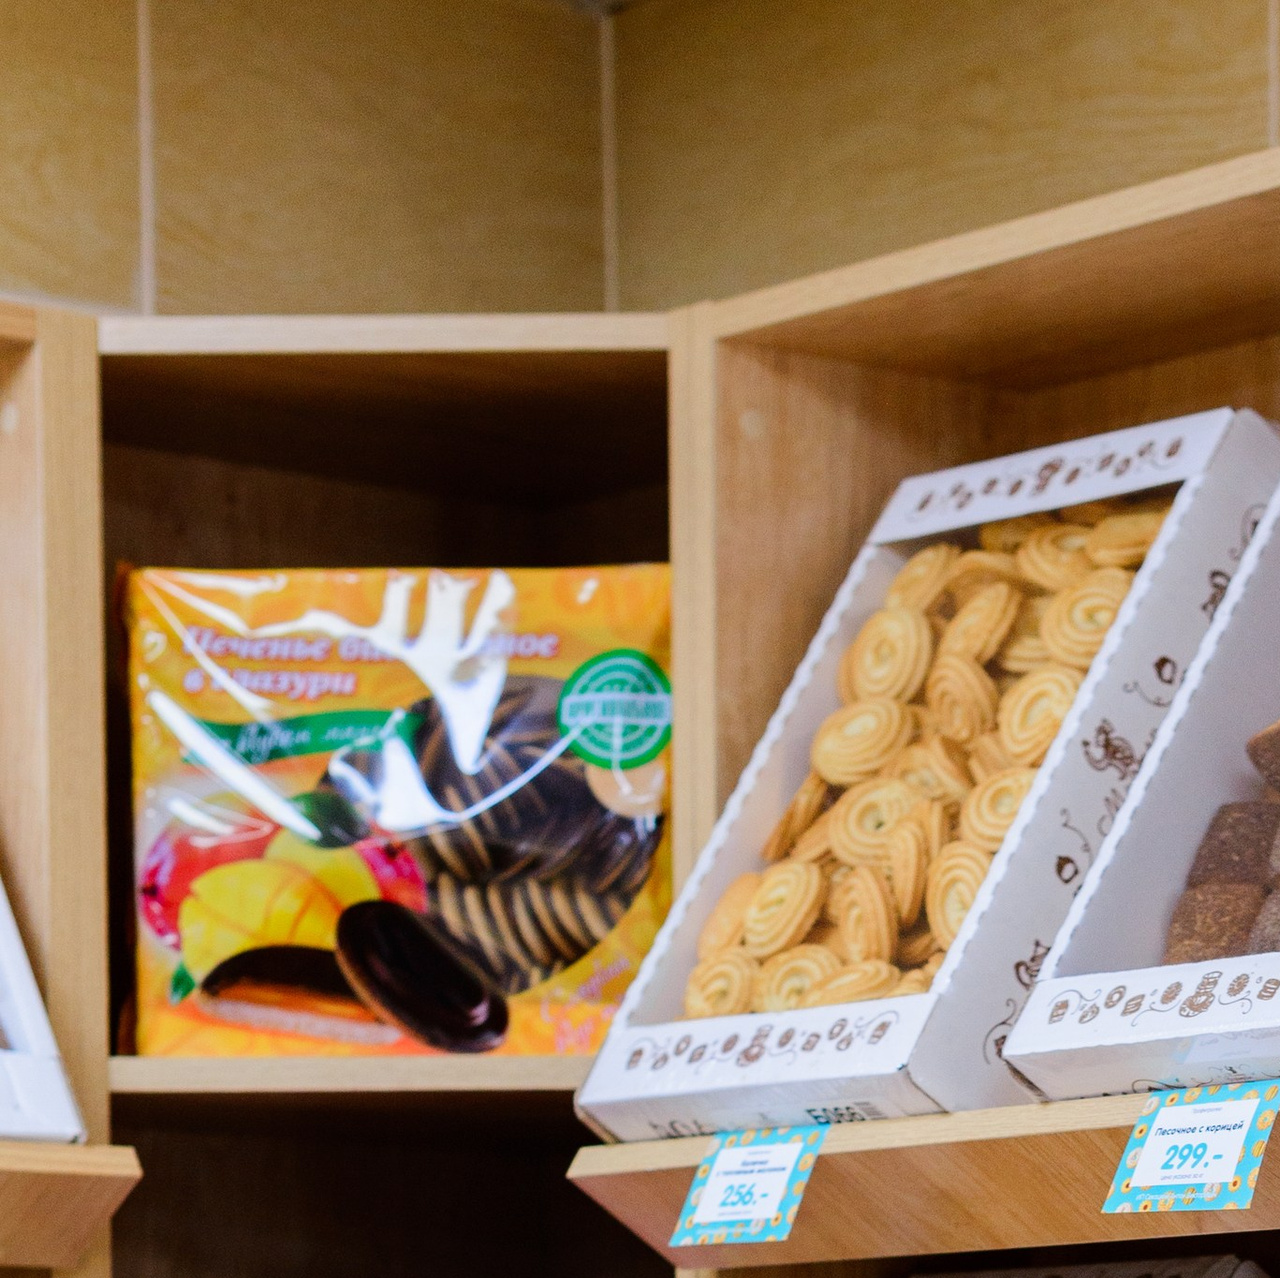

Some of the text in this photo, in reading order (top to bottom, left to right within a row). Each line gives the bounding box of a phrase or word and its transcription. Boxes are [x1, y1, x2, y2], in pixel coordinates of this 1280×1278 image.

[211, 670, 358, 698] лазури
[1154, 1125, 1197, 1137] Песочное
[1206, 1120, 1245, 1134] корицей
